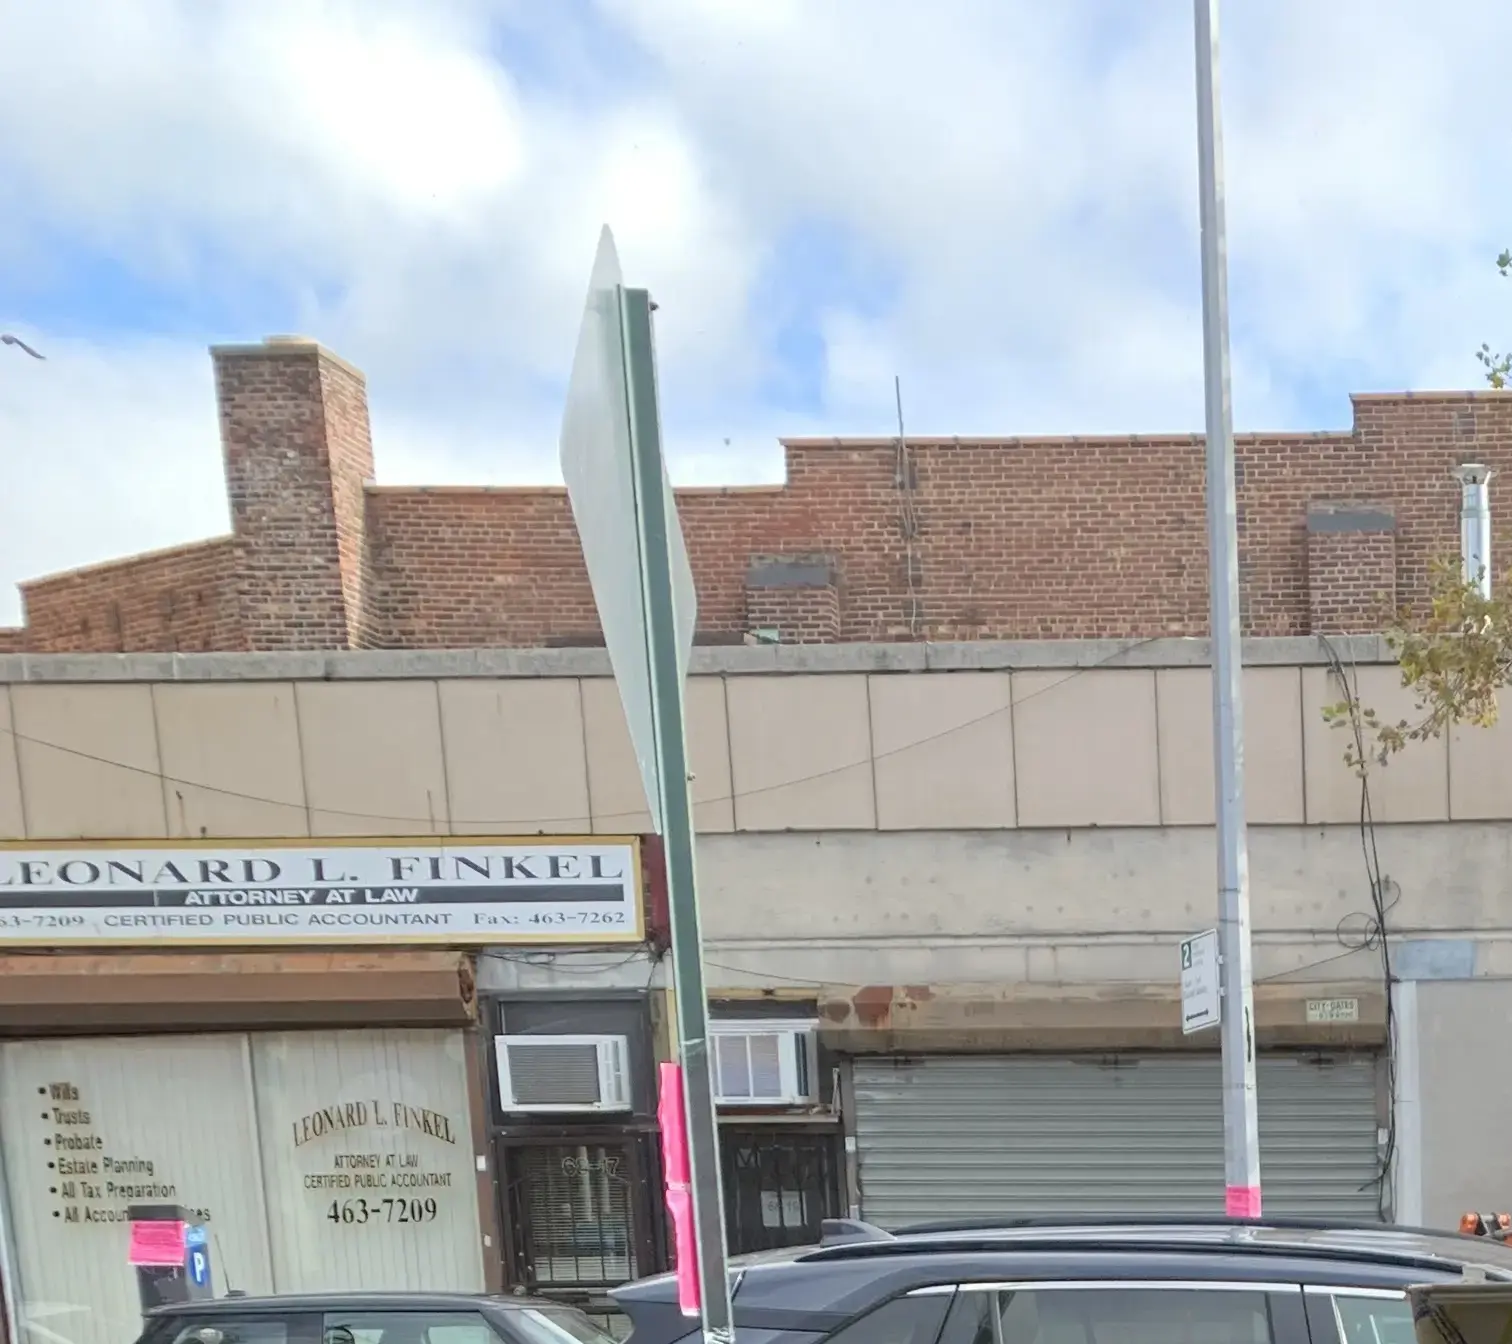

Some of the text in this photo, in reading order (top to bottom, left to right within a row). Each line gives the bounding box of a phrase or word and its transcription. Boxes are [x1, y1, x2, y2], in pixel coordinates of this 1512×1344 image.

[0, 855, 623, 886] EONARD L. FINKEL
[184, 888, 418, 906] ATTORNEY AT LAW
[104, 914, 213, 927] CERTIFIED
[223, 913, 299, 926] PUBLIC
[308, 913, 453, 926] ACCOUNTANT
[474, 913, 518, 925] Fax:
[528, 912, 625, 924] 463-7262
[49, 1082, 79, 1100] Wills
[52, 1107, 91, 1125] Trusts
[292, 1100, 456, 1147] LEONARD L. FINKEL
[55, 1133, 103, 1150] Probate
[58, 1156, 154, 1176] Estate Planning
[334, 1154, 419, 1169] ATTORNEY AT LAW
[304, 1172, 452, 1188] CERTIFIED PUBLIC ACCOUNTANT
[61, 1181, 176, 1200] All Tax Preparation
[64, 1206, 129, 1223] All Accoun
[327, 1198, 437, 1224] 463-7209
